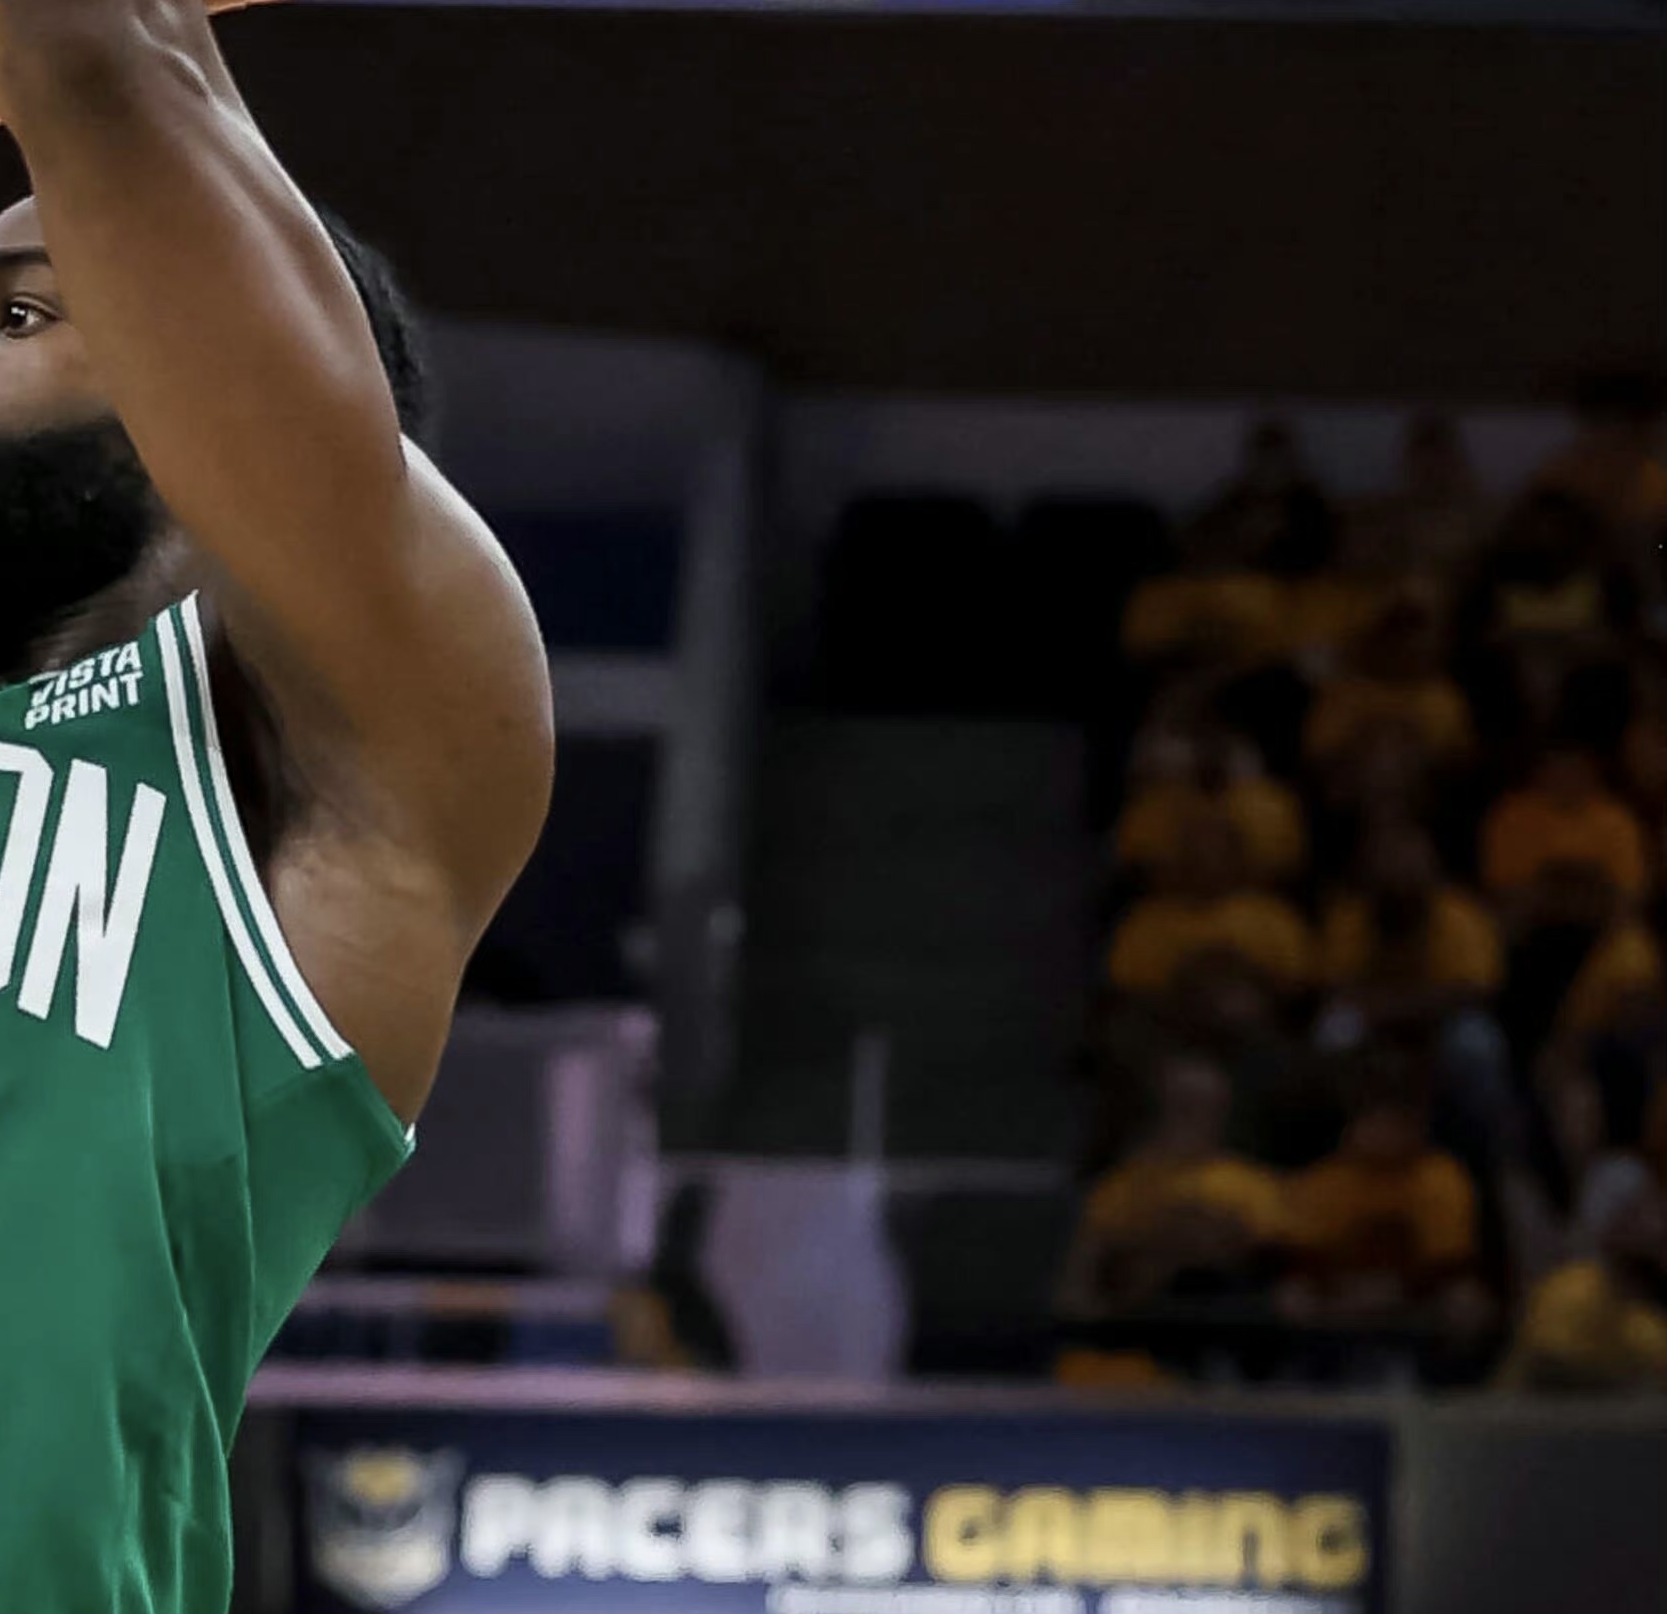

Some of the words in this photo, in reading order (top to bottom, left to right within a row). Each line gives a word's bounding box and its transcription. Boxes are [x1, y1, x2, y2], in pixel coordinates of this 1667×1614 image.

[24, 670, 144, 731] PRINT
[27, 640, 143, 707] VISTA
[461, 1474, 915, 1584] PACERS
[922, 1484, 1369, 1590] GAMING
